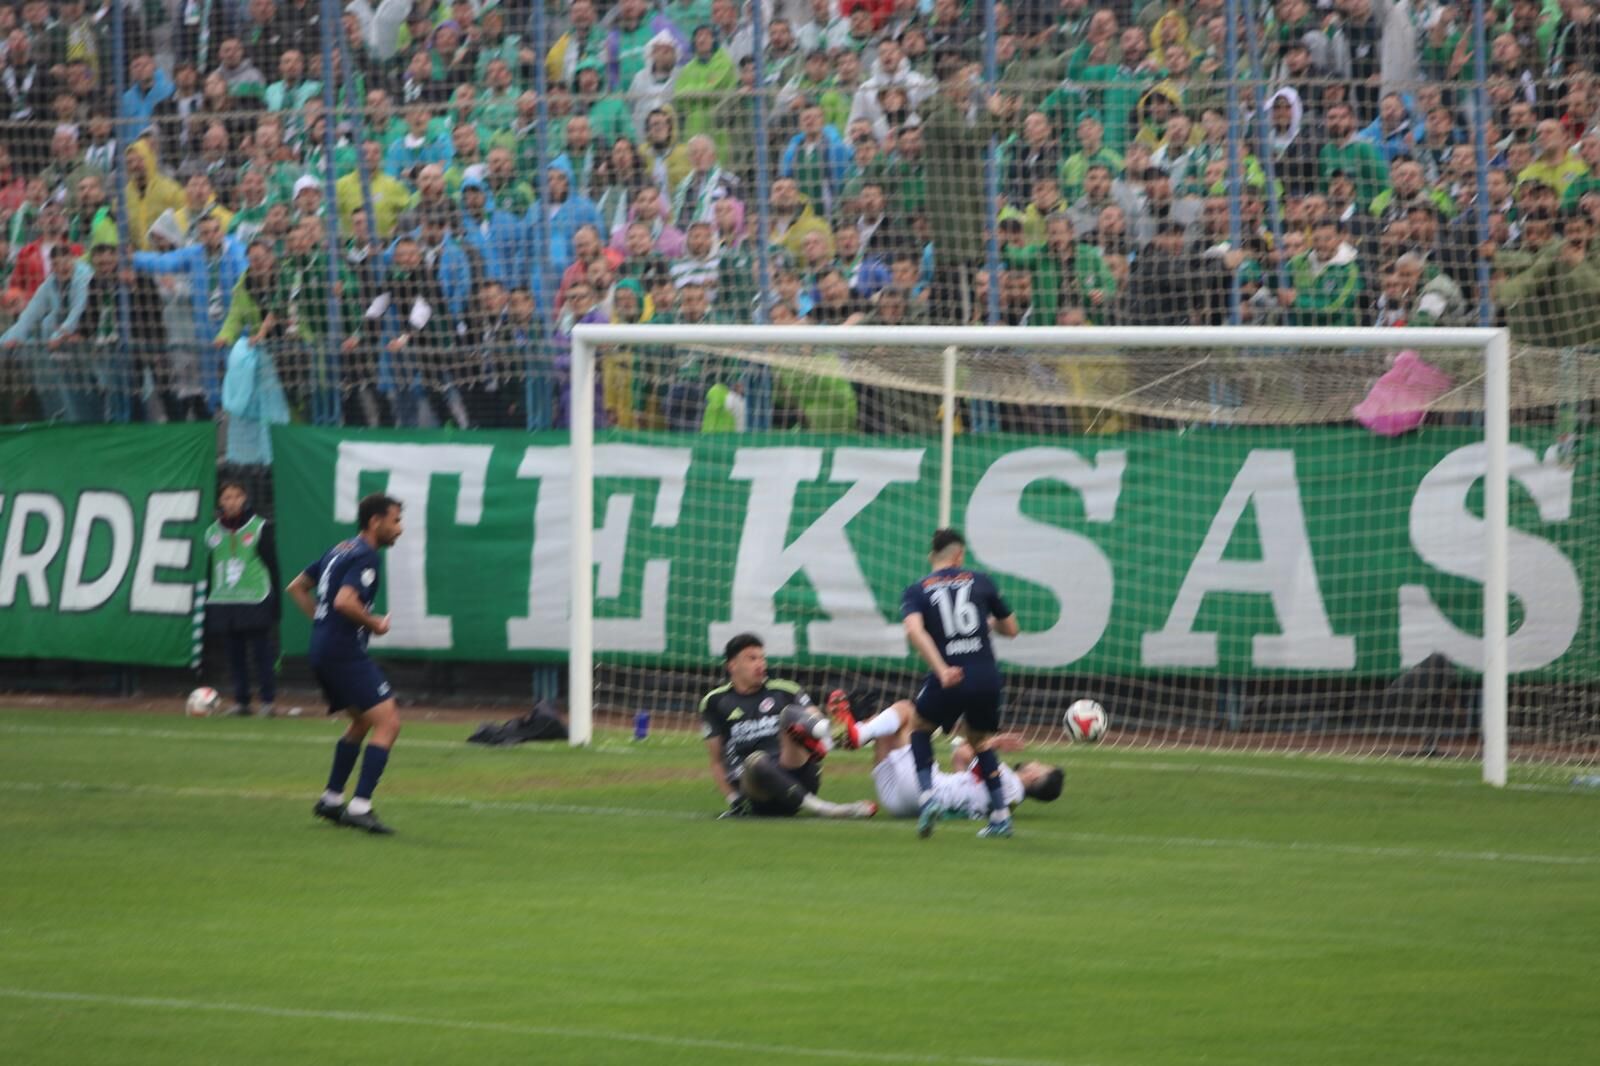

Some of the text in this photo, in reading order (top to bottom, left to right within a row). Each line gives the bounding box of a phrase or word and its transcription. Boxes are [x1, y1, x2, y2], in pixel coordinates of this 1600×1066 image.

[0, 488, 200, 614] RDE
[336, 441, 1582, 673] TEKSAS
[929, 580, 980, 638] 16
